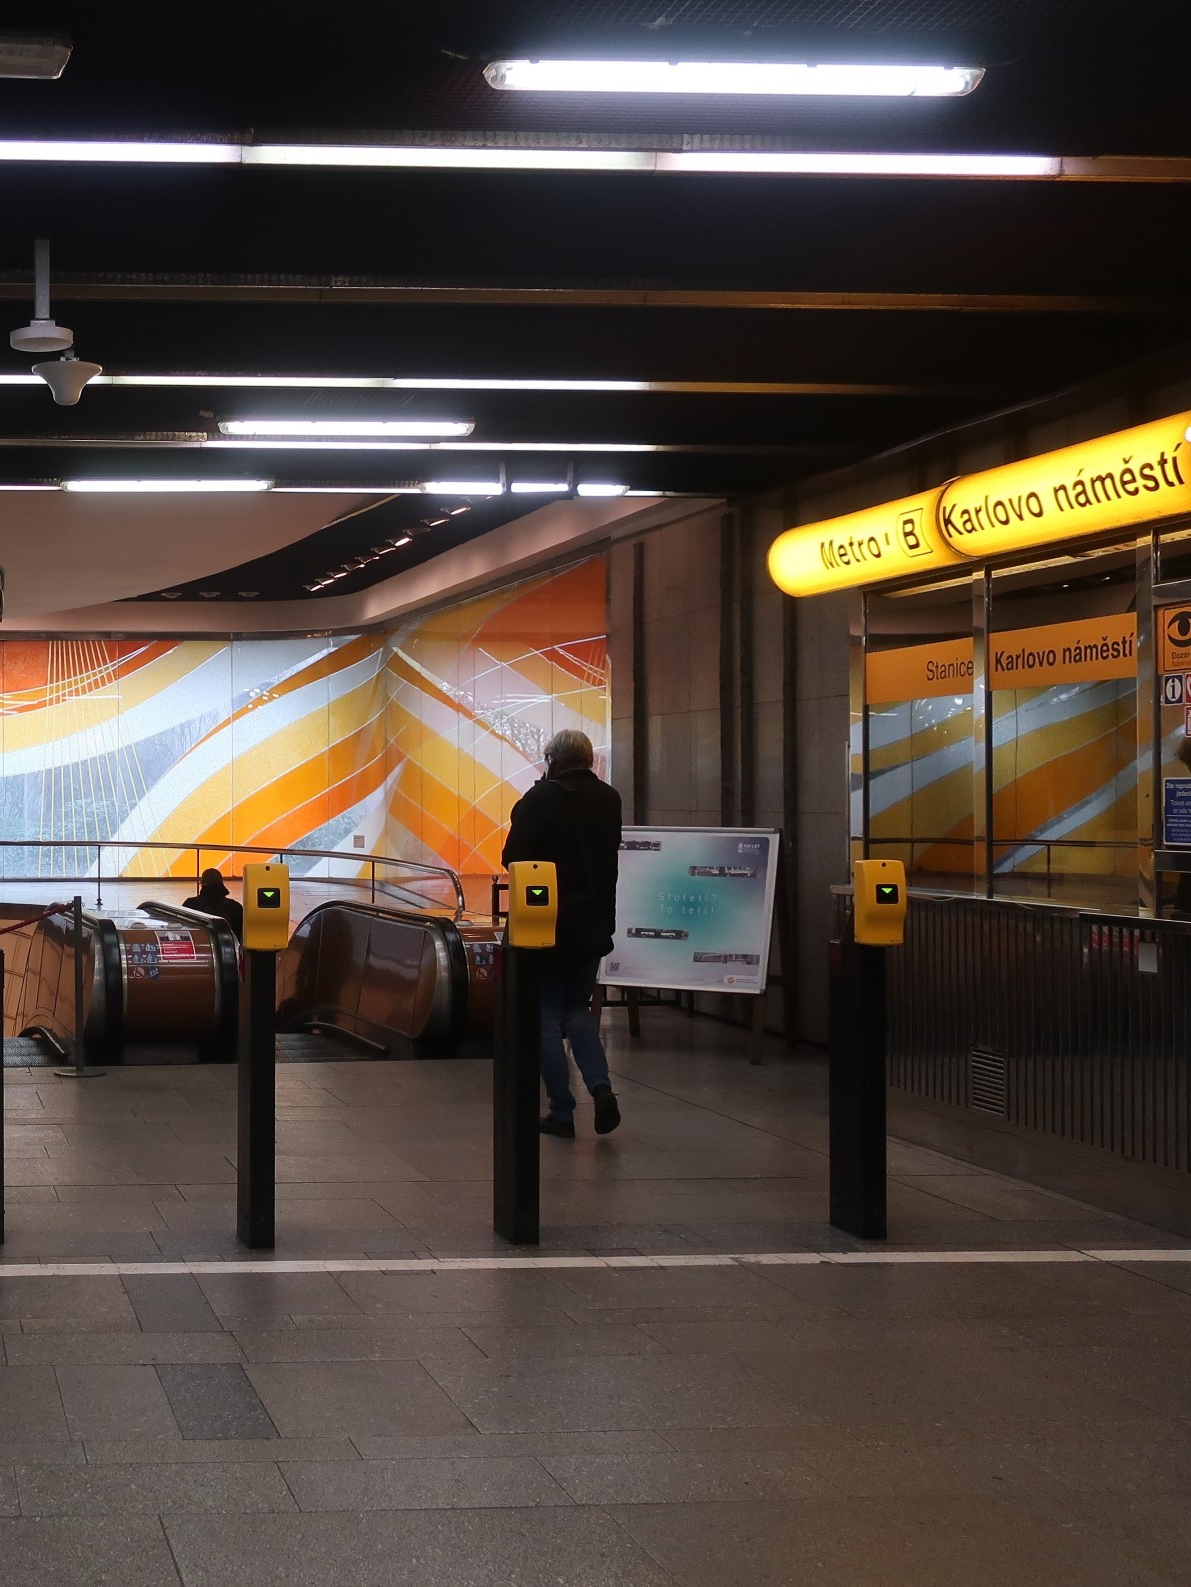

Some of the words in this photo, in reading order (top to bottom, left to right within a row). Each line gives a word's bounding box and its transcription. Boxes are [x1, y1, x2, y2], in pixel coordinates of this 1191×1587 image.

[820, 532, 882, 570] Metro
[902, 518, 921, 551] B
[941, 489, 1044, 539] Karlovo
[1053, 442, 1186, 513] náměstí
[926, 660, 974, 682] Stanice
[994, 649, 1057, 673] Karlovo
[1062, 632, 1136, 666] náměstí
